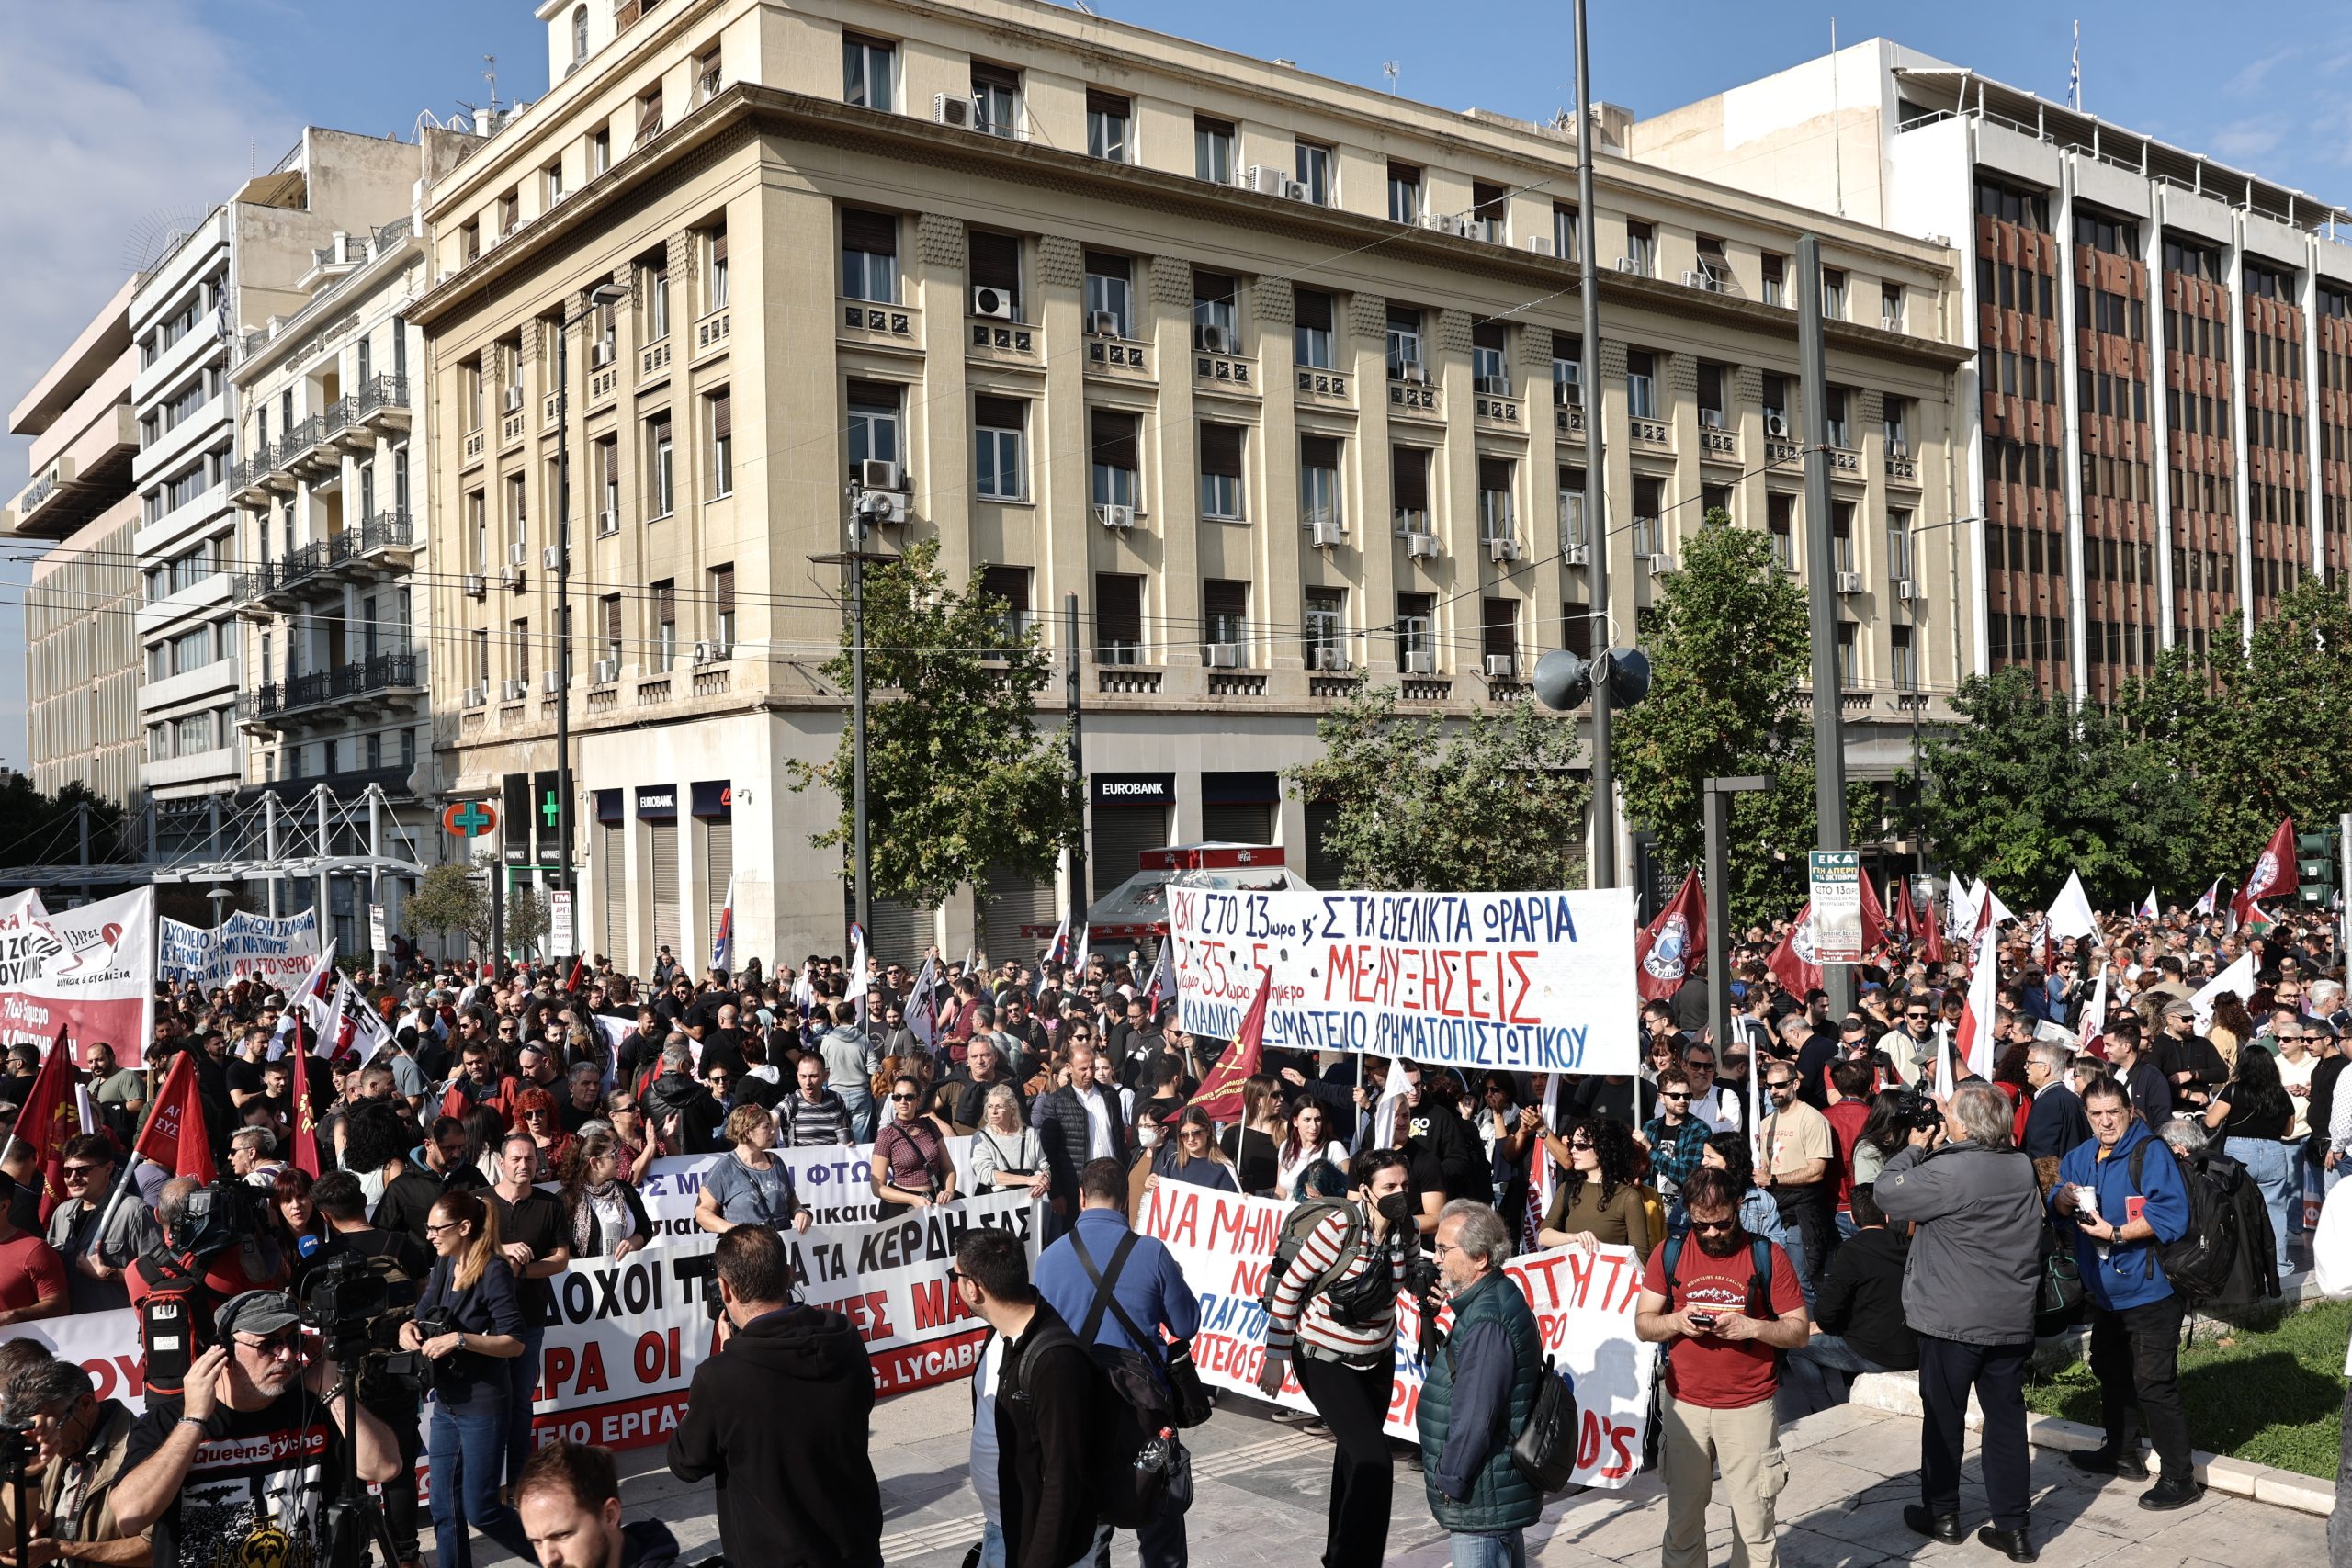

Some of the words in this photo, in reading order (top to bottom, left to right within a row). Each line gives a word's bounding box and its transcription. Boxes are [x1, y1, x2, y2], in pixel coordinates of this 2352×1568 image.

[639, 795, 673, 808] EUROBANK
[1102, 783, 1164, 795] EUROBANK
[1174, 891, 1195, 931] ΟΧΙ
[1202, 894, 1238, 935] ΣΤΟ
[1483, 895, 1578, 943] ΩΡΑΡΙΑ
[164, 920, 209, 950] ΣΧΟΛΕΙΟ
[173, 945, 203, 966] ΜΕΝΕΙ
[208, 936, 239, 964] ΧΡΝΟΣ
[234, 958, 252, 976] ΟΧΙ
[256, 957, 276, 976] ΣΤΟ
[1261, 1010, 1367, 1049] ΩΜΑΤΕΙΟ
[1373, 1011, 1589, 1069] ΧΡΗΜΑΤΟΠΙΣΤΩΤΙΚΟΥ
[1146, 1186, 1199, 1248] ΝΑ
[812, 1243, 848, 1283] ΤΑ
[857, 1210, 967, 1275] ΚΕΡΔΗ
[634, 1326, 681, 1384] ΟΙ
[910, 1278, 980, 1331] ΜΑ
[192, 1431, 325, 1466] Queensrÿche
[74, 1482, 88, 1513] Canon
